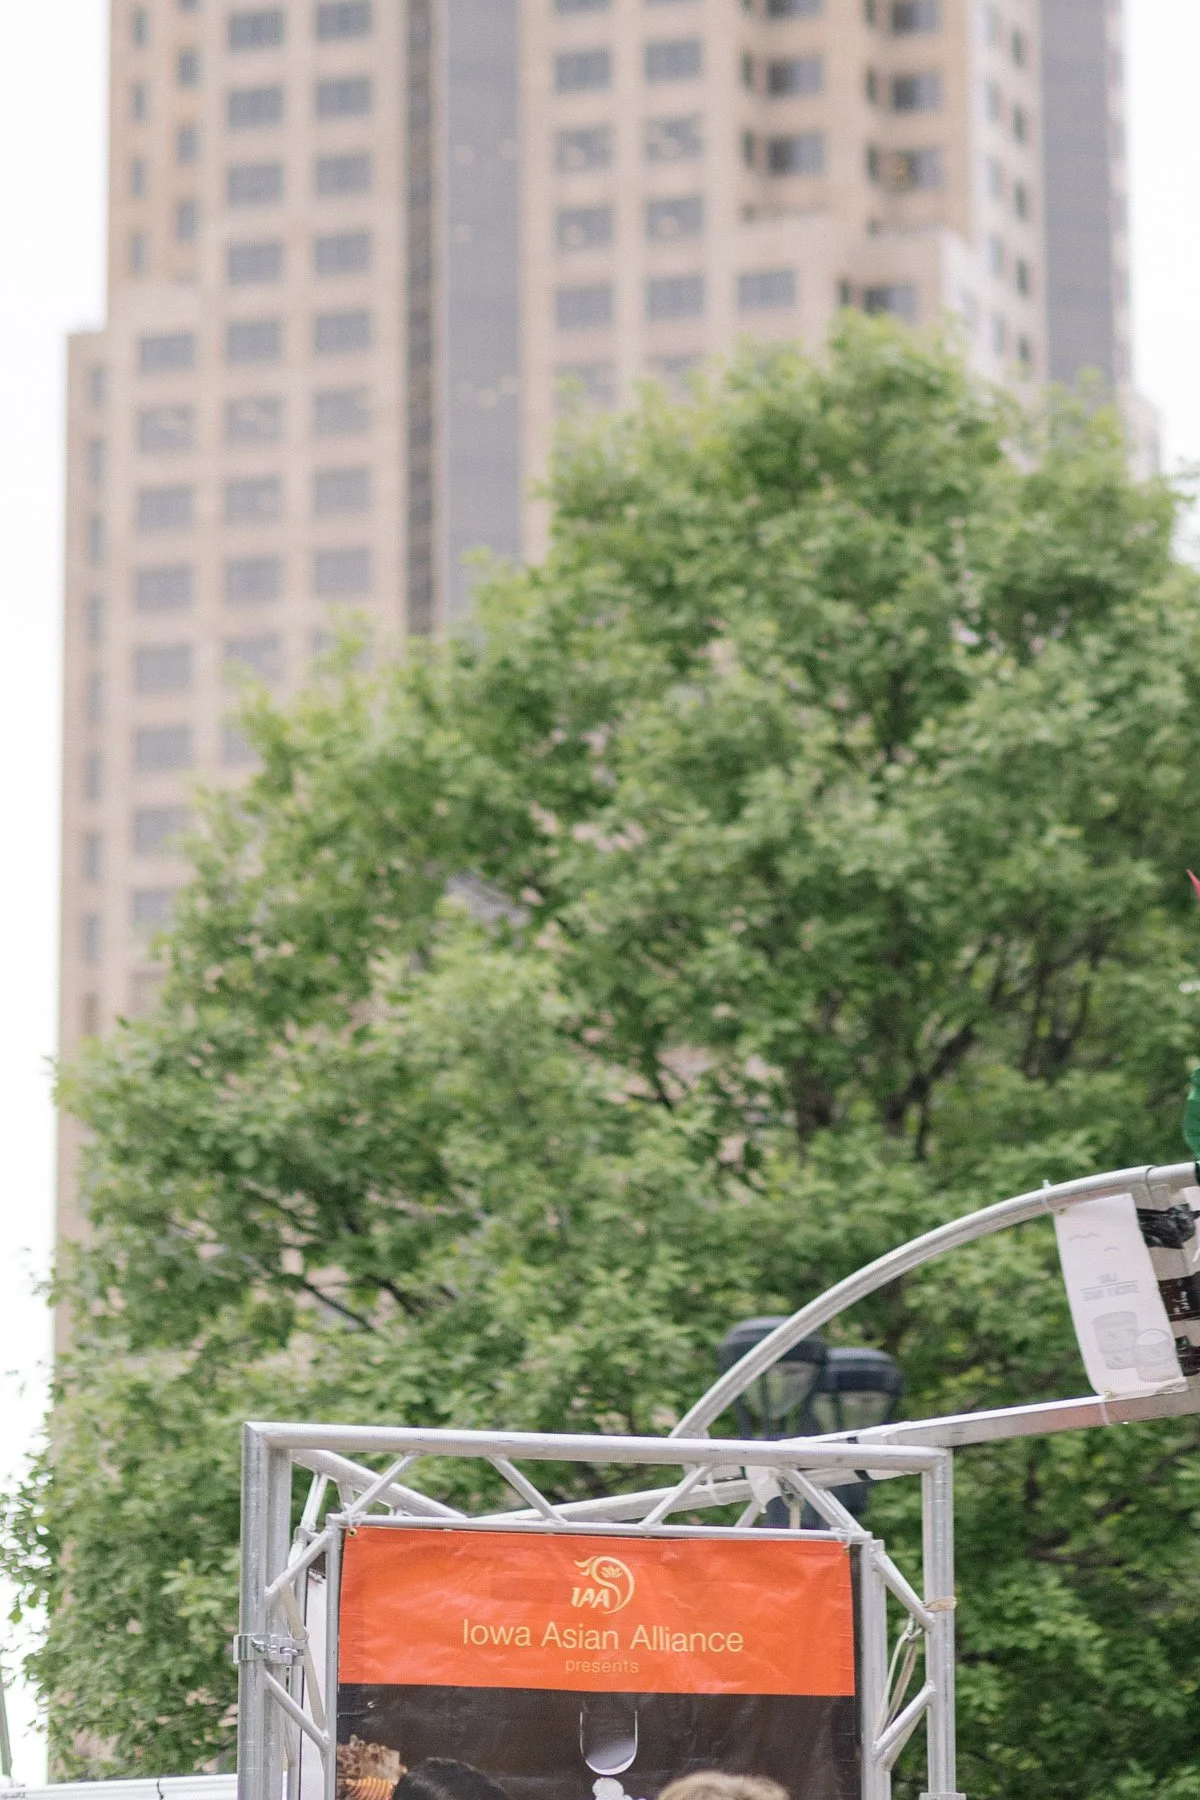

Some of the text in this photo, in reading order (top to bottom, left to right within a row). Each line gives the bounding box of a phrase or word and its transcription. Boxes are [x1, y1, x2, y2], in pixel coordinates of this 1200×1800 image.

[571, 1586, 611, 1609] IAA
[462, 1618, 745, 1653] Iowa Asian Alliance
[564, 1659, 640, 1675] presents
